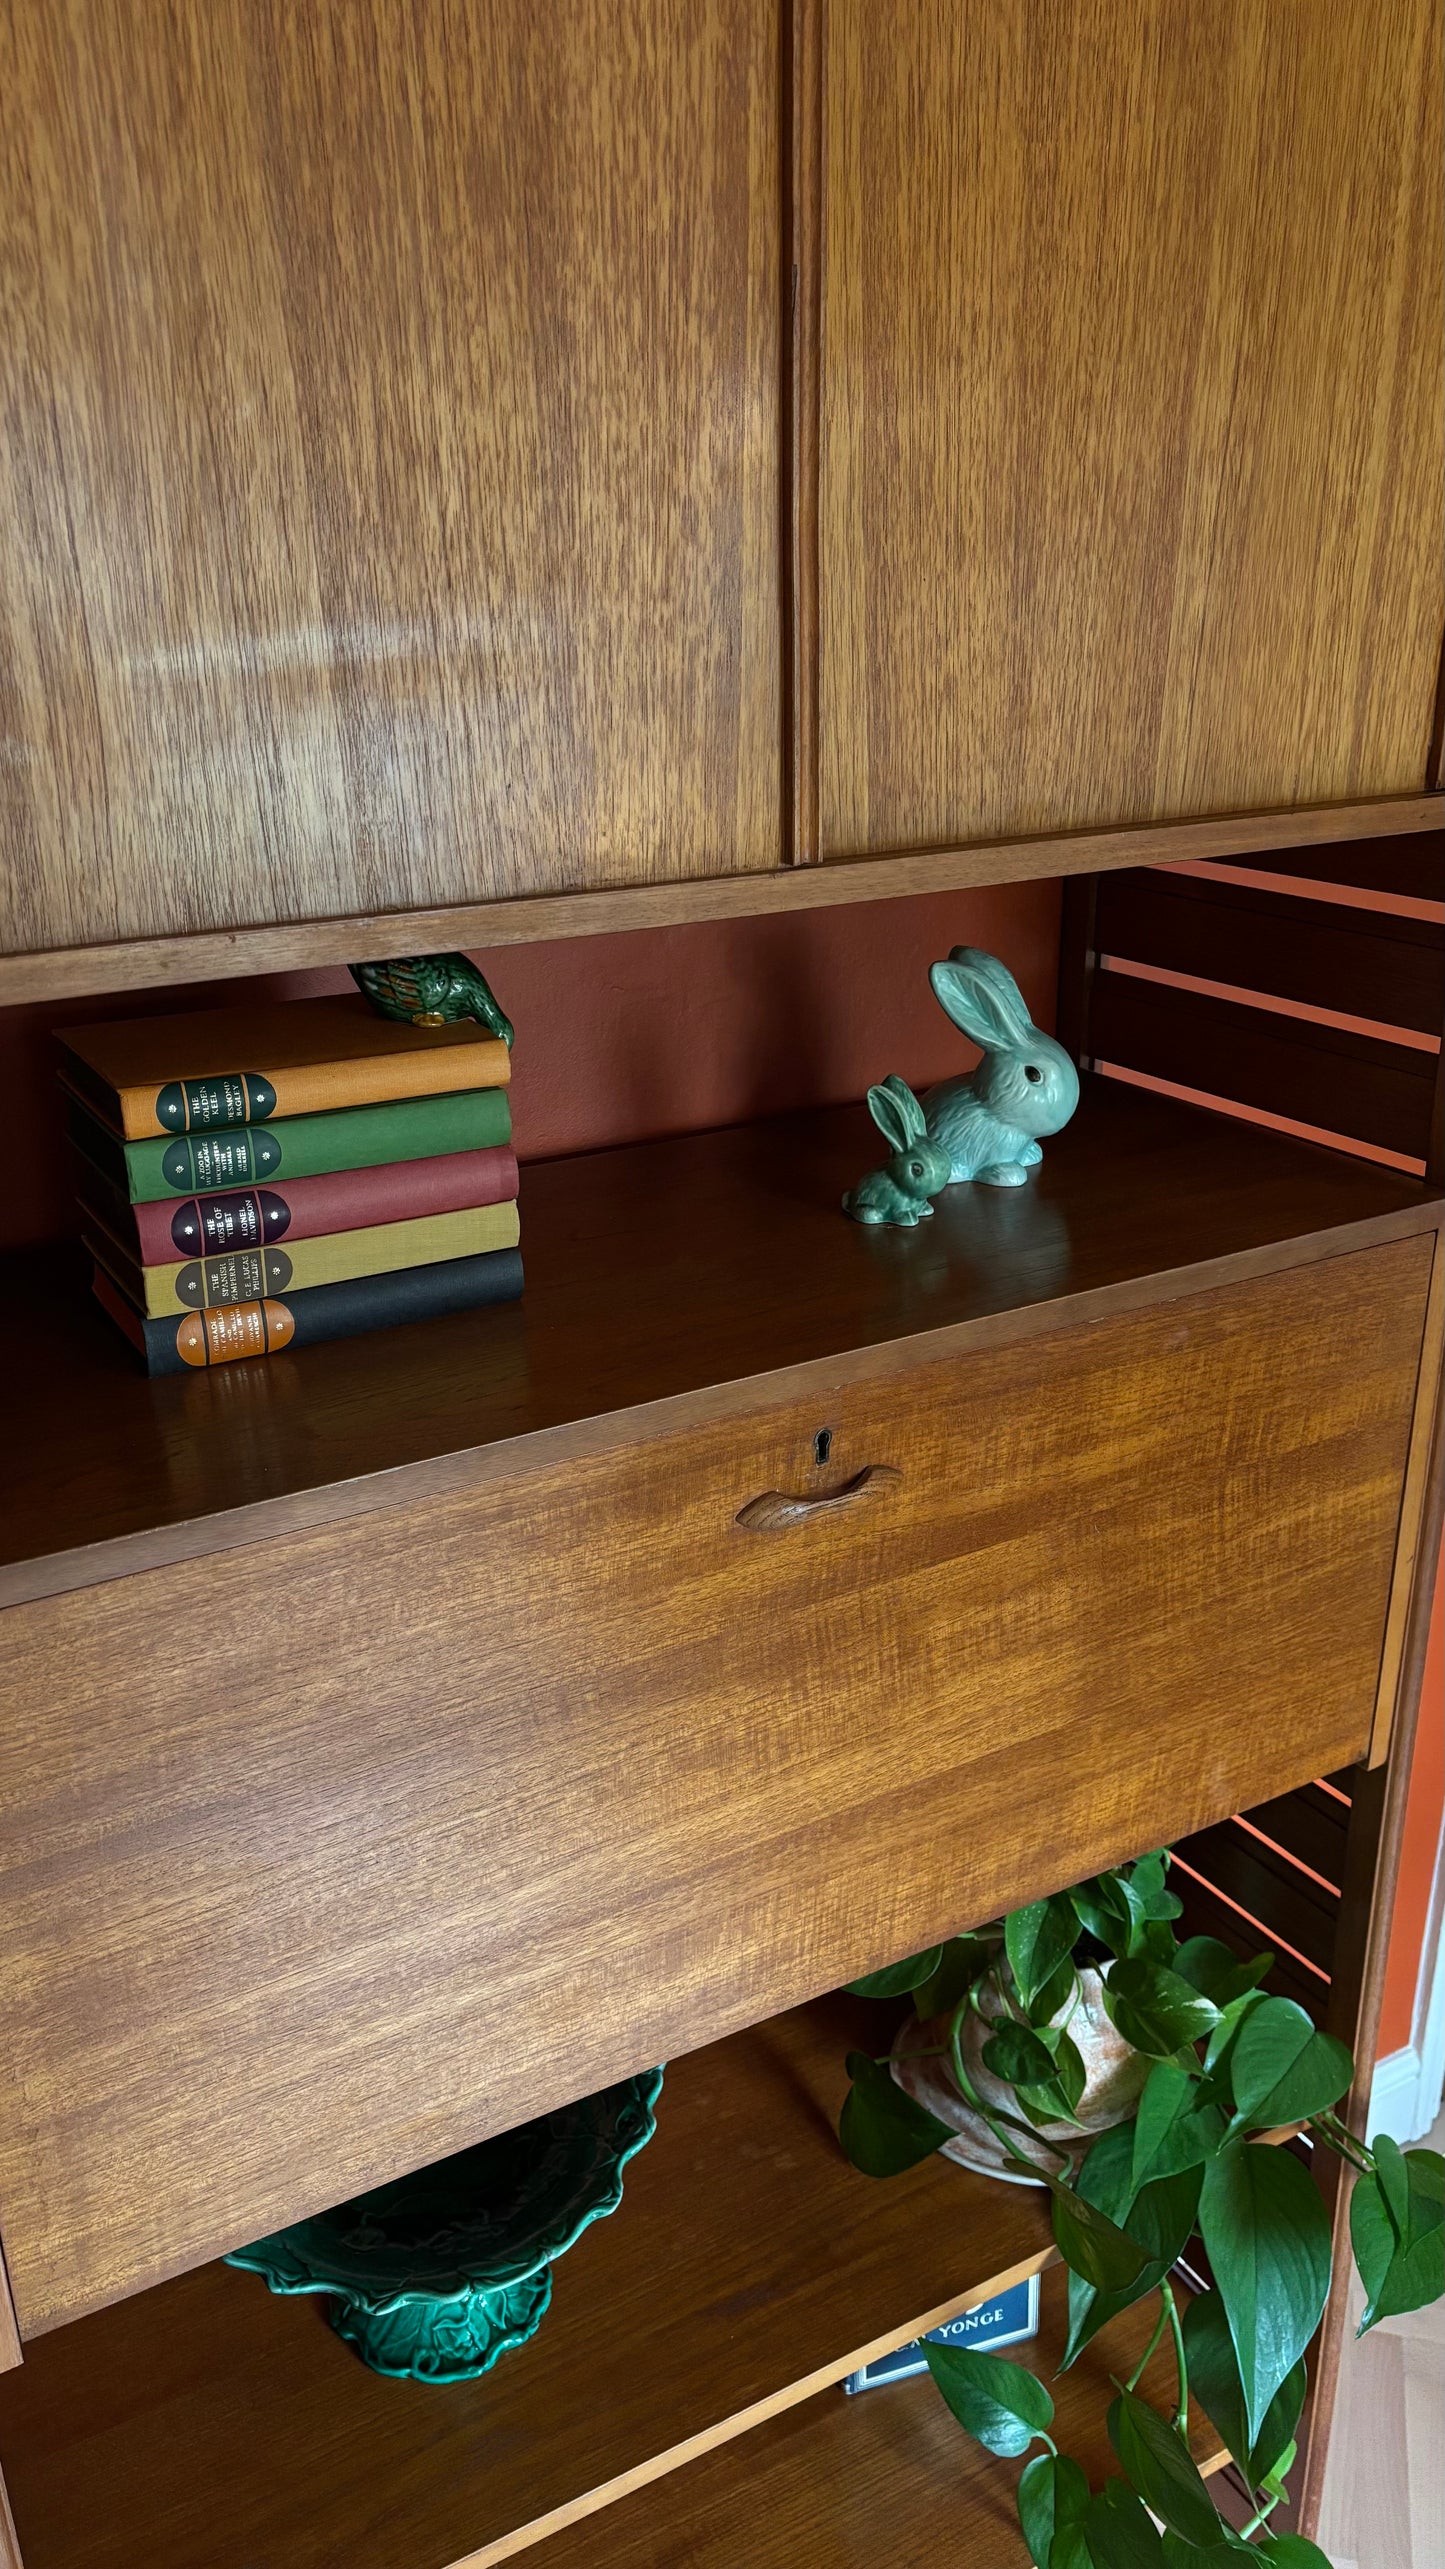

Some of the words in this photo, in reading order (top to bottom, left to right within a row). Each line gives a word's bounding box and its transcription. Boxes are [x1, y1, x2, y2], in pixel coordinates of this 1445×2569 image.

[192, 1097, 200, 1116] THE
[199, 1086, 210, 1123] GOLDEN
[210, 1092, 219, 1115] KEEL
[224, 1081, 235, 1121] DESMOND
[232, 1085, 243, 1117] BAGLEY
[197, 1151, 204, 1159] IN
[202, 1141, 211, 1175] LUGGAGE
[212, 1141, 222, 1184] ENCOUNTERS
[226, 1146, 234, 1176] ANIMALS
[206, 1218, 215, 1237] THE
[213, 1207, 223, 1220] OF
[224, 1212, 234, 1238] TIBET
[239, 1207, 248, 1236] LIONEL
[245, 1199, 256, 1241] DAVIDSON
[216, 1222, 225, 1244] ROSE
[211, 1274, 219, 1291] THE
[219, 1263, 229, 1297] SPANISH
[228, 1255, 238, 1301] PIMPERNEL
[241, 1255, 251, 1280] LUCAS
[250, 1258, 260, 1292] PHILLIPS
[938, 2308, 1004, 2338] YONGE
